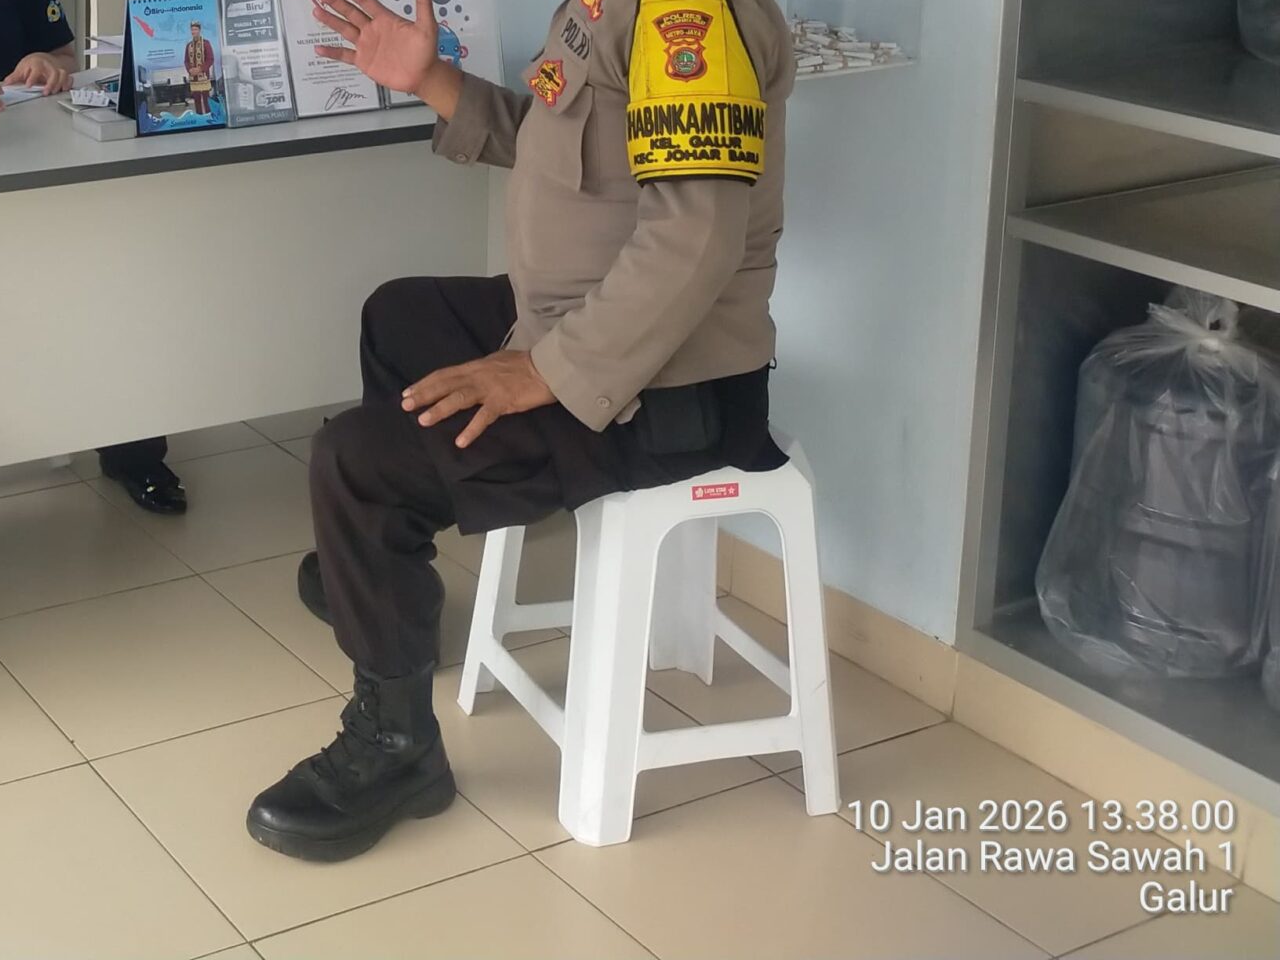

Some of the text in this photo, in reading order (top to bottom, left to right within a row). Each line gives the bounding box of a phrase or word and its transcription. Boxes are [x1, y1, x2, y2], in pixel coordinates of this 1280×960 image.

[245, 2, 264, 11] Biru
[561, 17, 591, 60] POLRI
[650, 135, 742, 150] KEL. GALUR
[634, 149, 759, 165] KEC. JOHAR BARU
